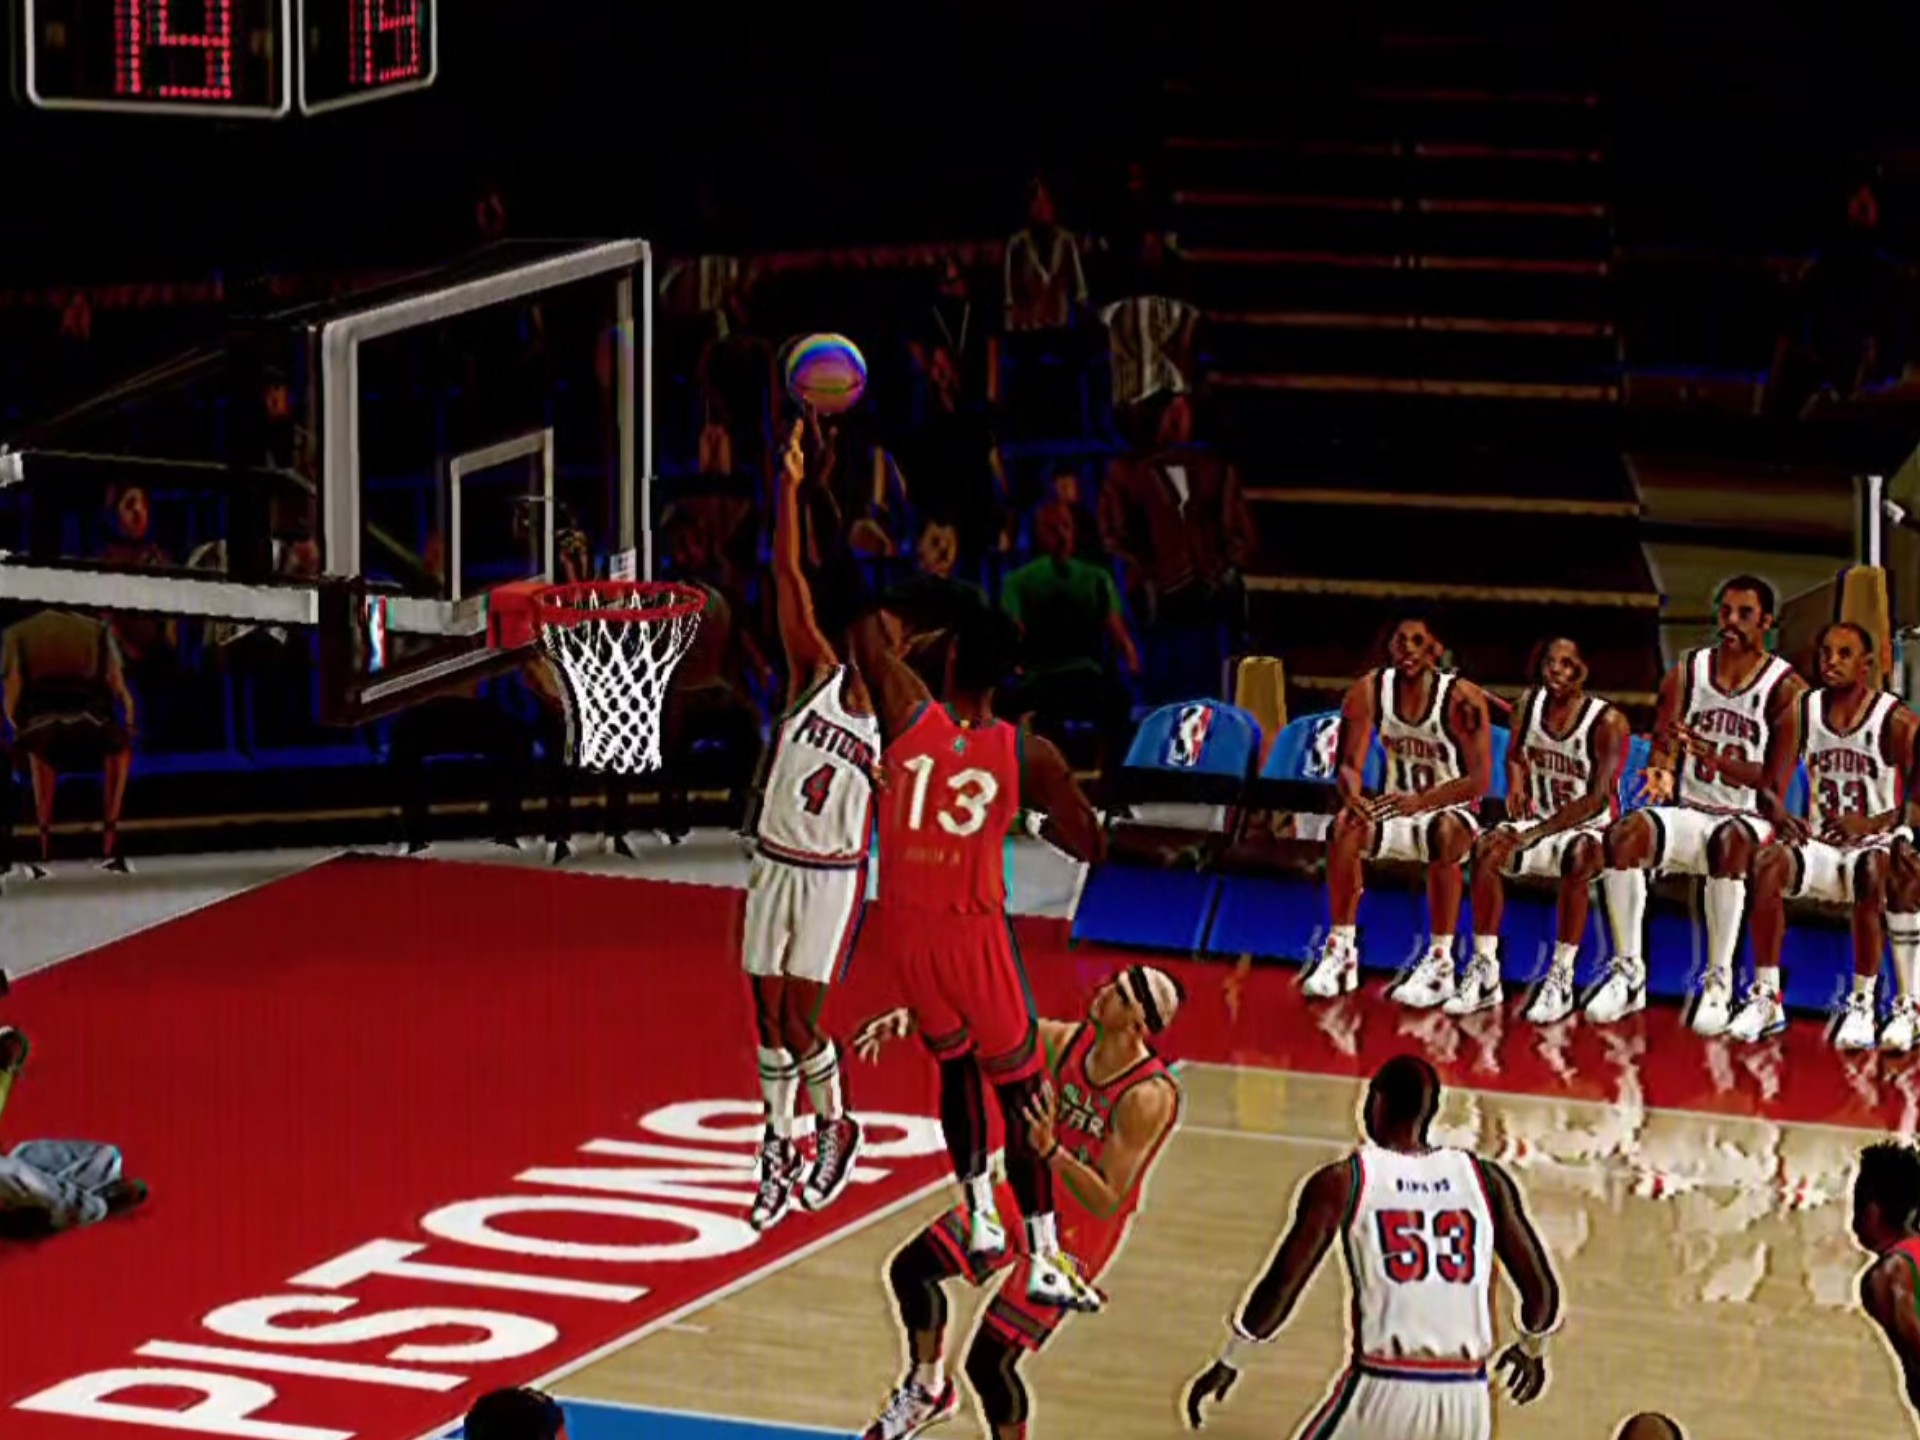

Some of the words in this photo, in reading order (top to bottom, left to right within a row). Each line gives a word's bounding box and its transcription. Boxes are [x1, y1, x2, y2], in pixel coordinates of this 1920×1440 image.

[801, 762, 837, 816] 4
[904, 754, 998, 836] 13
[1818, 776, 1868, 819] 33
[1375, 1207, 1478, 1284] 53
